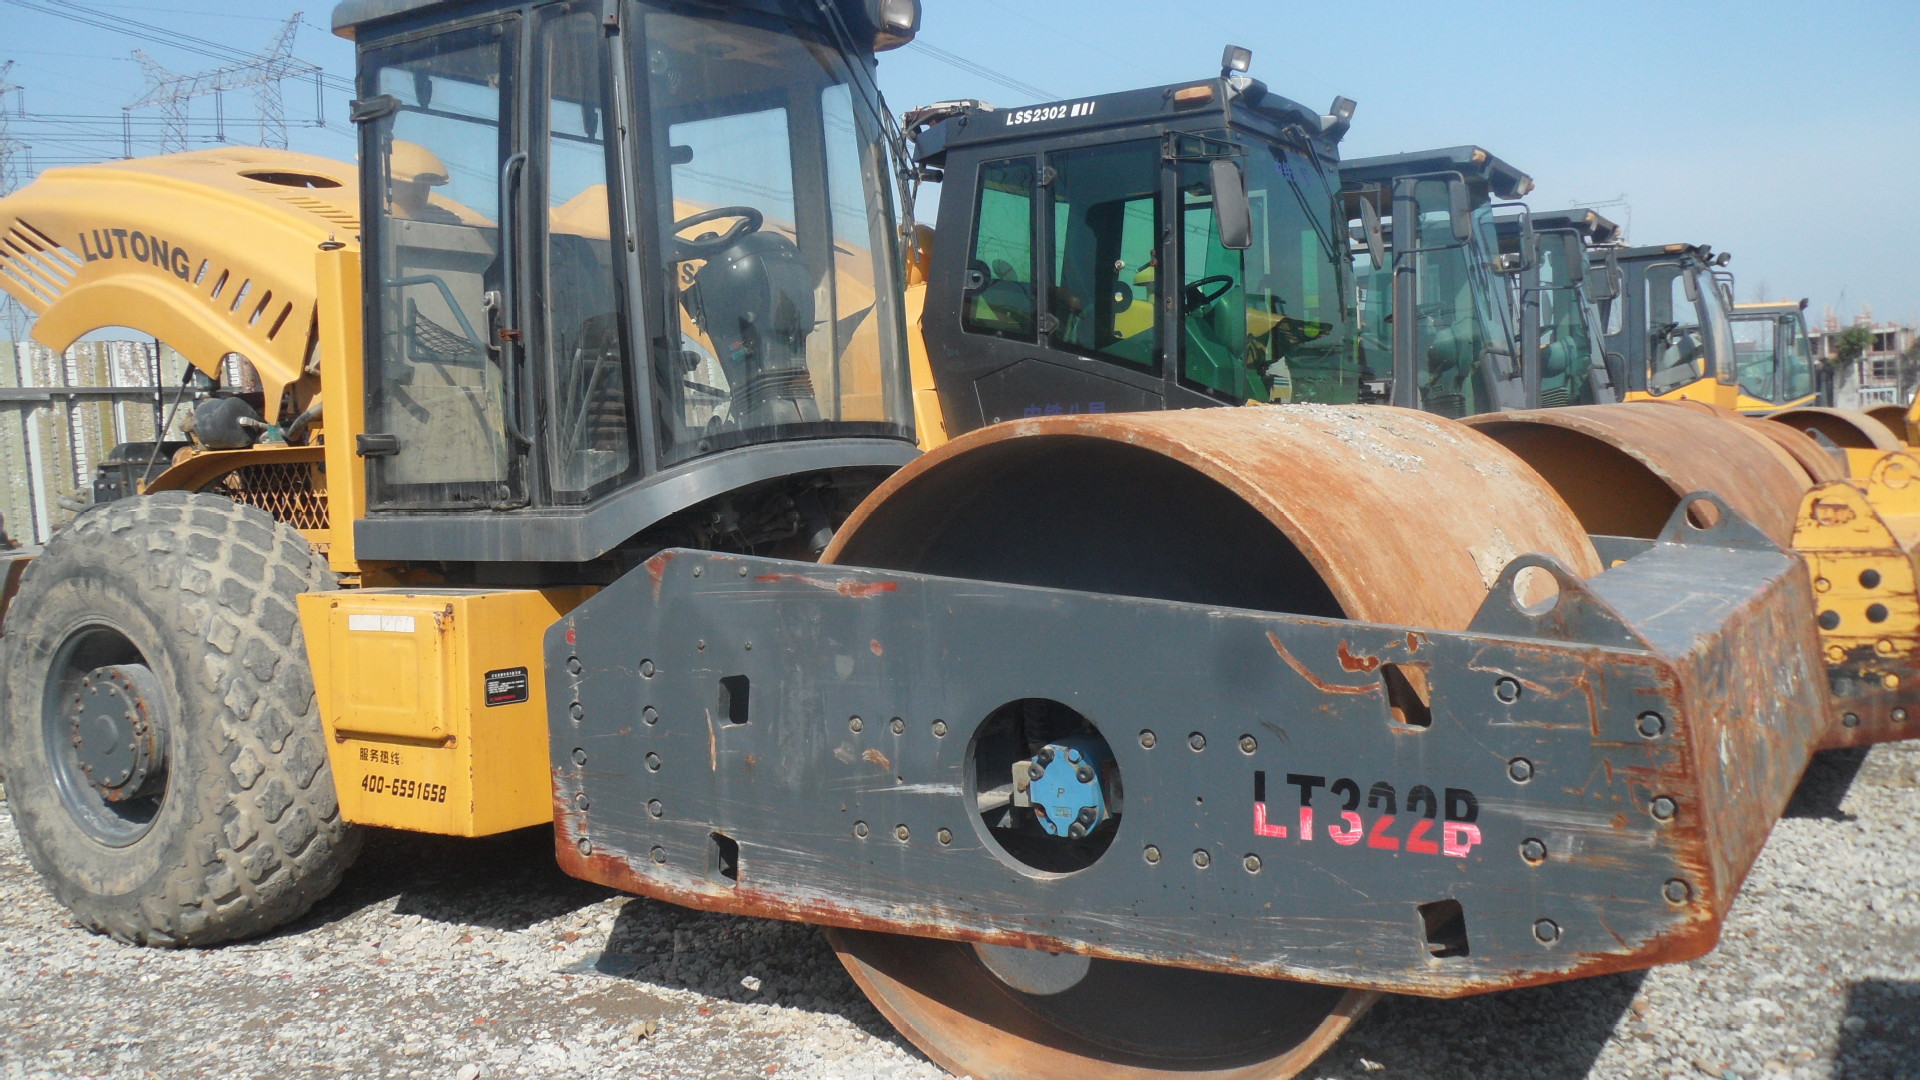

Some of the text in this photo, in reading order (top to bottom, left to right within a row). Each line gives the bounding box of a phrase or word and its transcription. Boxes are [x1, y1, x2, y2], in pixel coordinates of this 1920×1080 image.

[1006, 105, 1067, 126] LSS2302
[79, 228, 190, 283] LUTONG
[361, 774, 447, 804] 400-6591658
[1056, 787, 1066, 799] P
